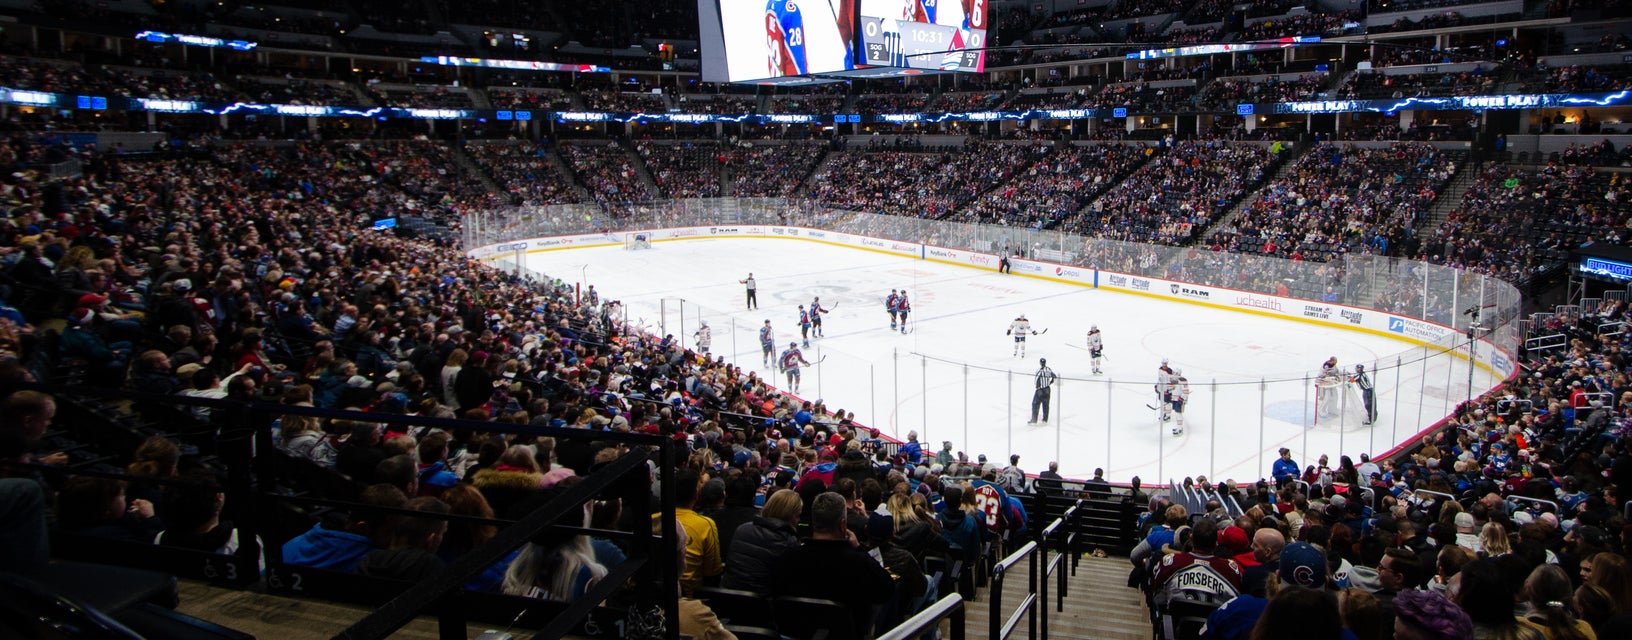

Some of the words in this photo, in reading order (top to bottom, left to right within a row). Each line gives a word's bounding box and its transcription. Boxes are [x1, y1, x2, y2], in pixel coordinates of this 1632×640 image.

[789, 27, 802, 46] 28
[866, 22, 877, 37] 0
[912, 29, 943, 43] 10:31
[971, 34, 980, 46] 0
[873, 51, 880, 60] 2
[967, 59, 973, 67] 7
[1292, 102, 1324, 111] POWER
[1325, 101, 1350, 110] PLAY
[1462, 96, 1505, 107] POWER
[1507, 95, 1540, 106] PLAY
[1064, 269, 1079, 278] pepsi
[1589, 261, 1606, 271] BUD
[1607, 263, 1632, 276] LIGHT
[1182, 288, 1209, 297] RAM
[1236, 294, 1281, 312] uchealth
[1304, 310, 1319, 318] GAMES
[1405, 319, 1425, 329] PACIFIC
[1426, 325, 1445, 335] OFFICE
[1405, 326, 1441, 342] AUTOMATION
[981, 486, 993, 496] ROY
[226, 562, 237, 580] 3
[291, 576, 303, 591] 2
[1176, 571, 1225, 597] FORSBERG
[615, 620, 625, 638] 1
